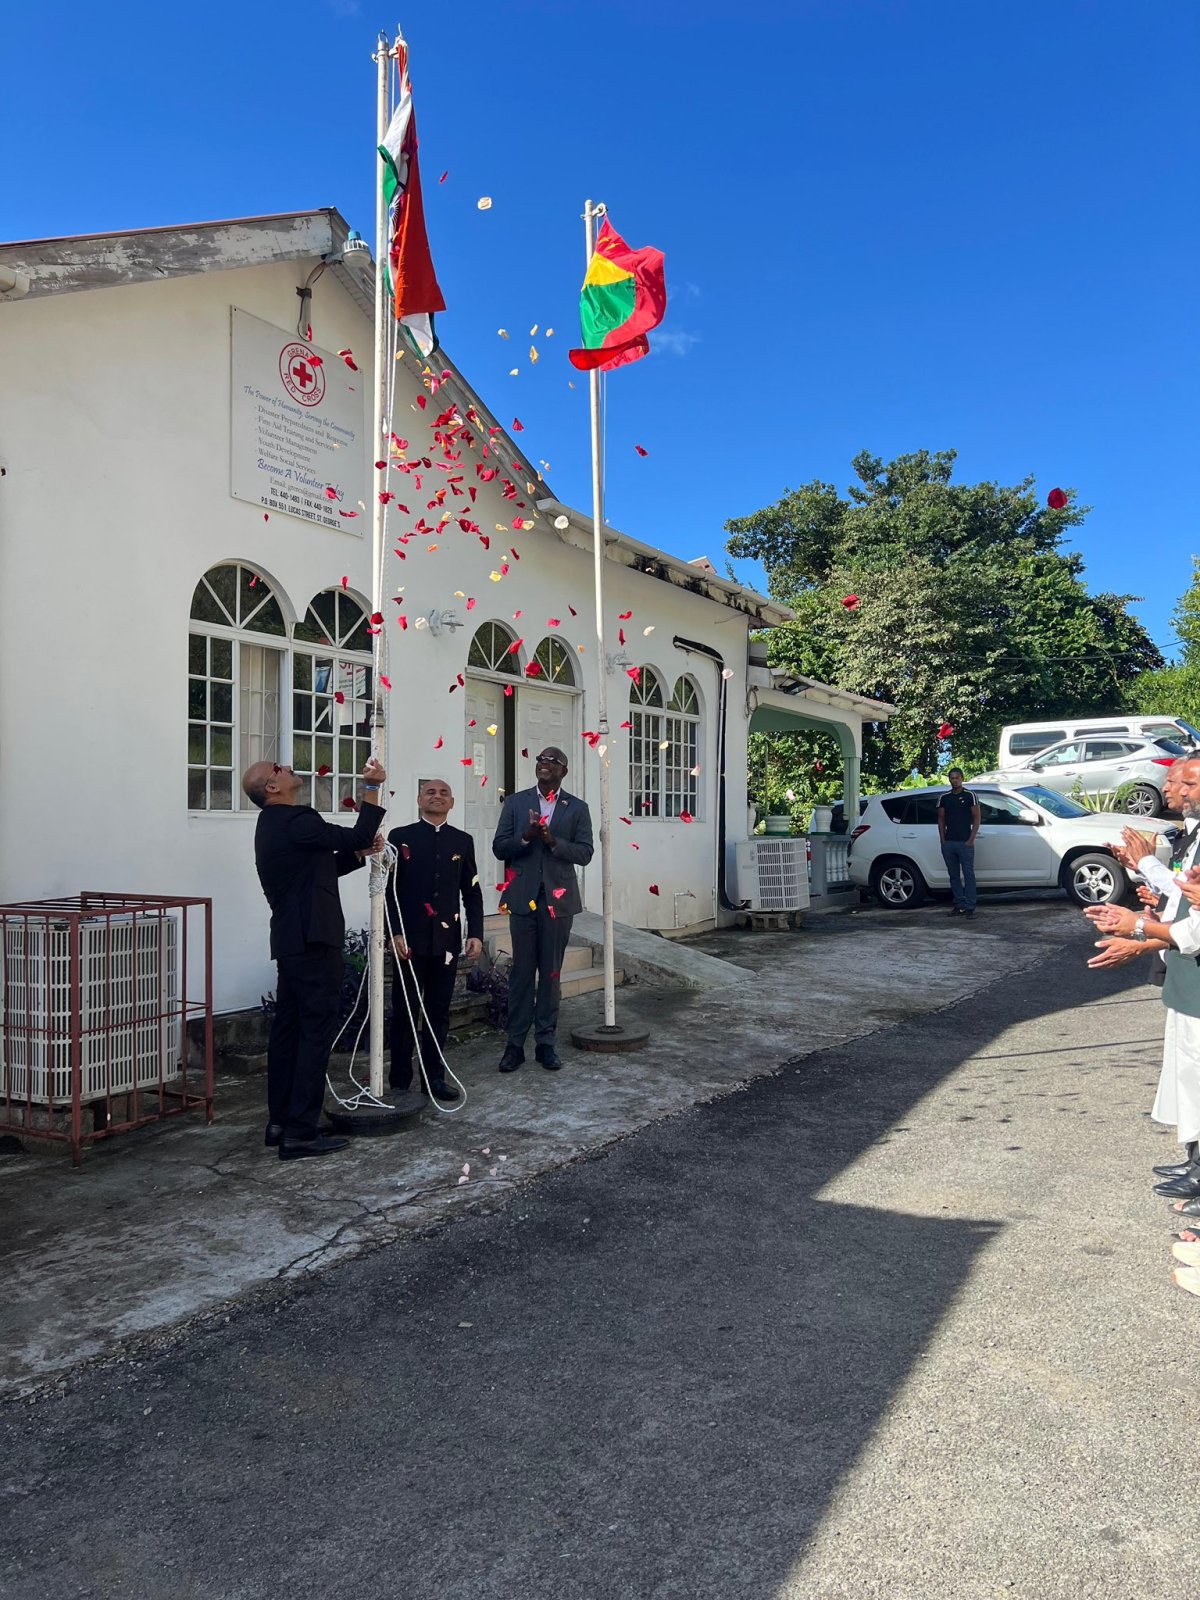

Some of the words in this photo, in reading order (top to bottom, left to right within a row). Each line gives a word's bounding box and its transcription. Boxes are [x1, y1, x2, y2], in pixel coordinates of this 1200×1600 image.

[284, 373, 296, 393] RED
[302, 387, 321, 402] CROSS
[244, 386, 254, 396] The
[255, 390, 271, 402] Power
[304, 412, 322, 428] Serving
[330, 422, 355, 441] Community
[258, 405, 280, 418] Disaster
[281, 414, 314, 433] Preparedness
[315, 429, 324, 437] and
[326, 432, 348, 447] Response
[258, 416, 270, 426] First
[272, 422, 282, 430] Aid
[283, 426, 304, 441] Training
[305, 435, 314, 443] and
[258, 426, 284, 441] Volunteer
[286, 437, 318, 454] Management
[258, 437, 274, 448] Youth
[276, 444, 310, 462] Development
[258, 448, 278, 460] Welfare
[280, 456, 295, 467] Social
[296, 462, 316, 474] Services
[258, 458, 284, 476] Become
[284, 469, 292, 478] A
[294, 470, 324, 490] Volunteer
[270, 499, 278, 508] BOX
[288, 506, 301, 516] LUCAS
